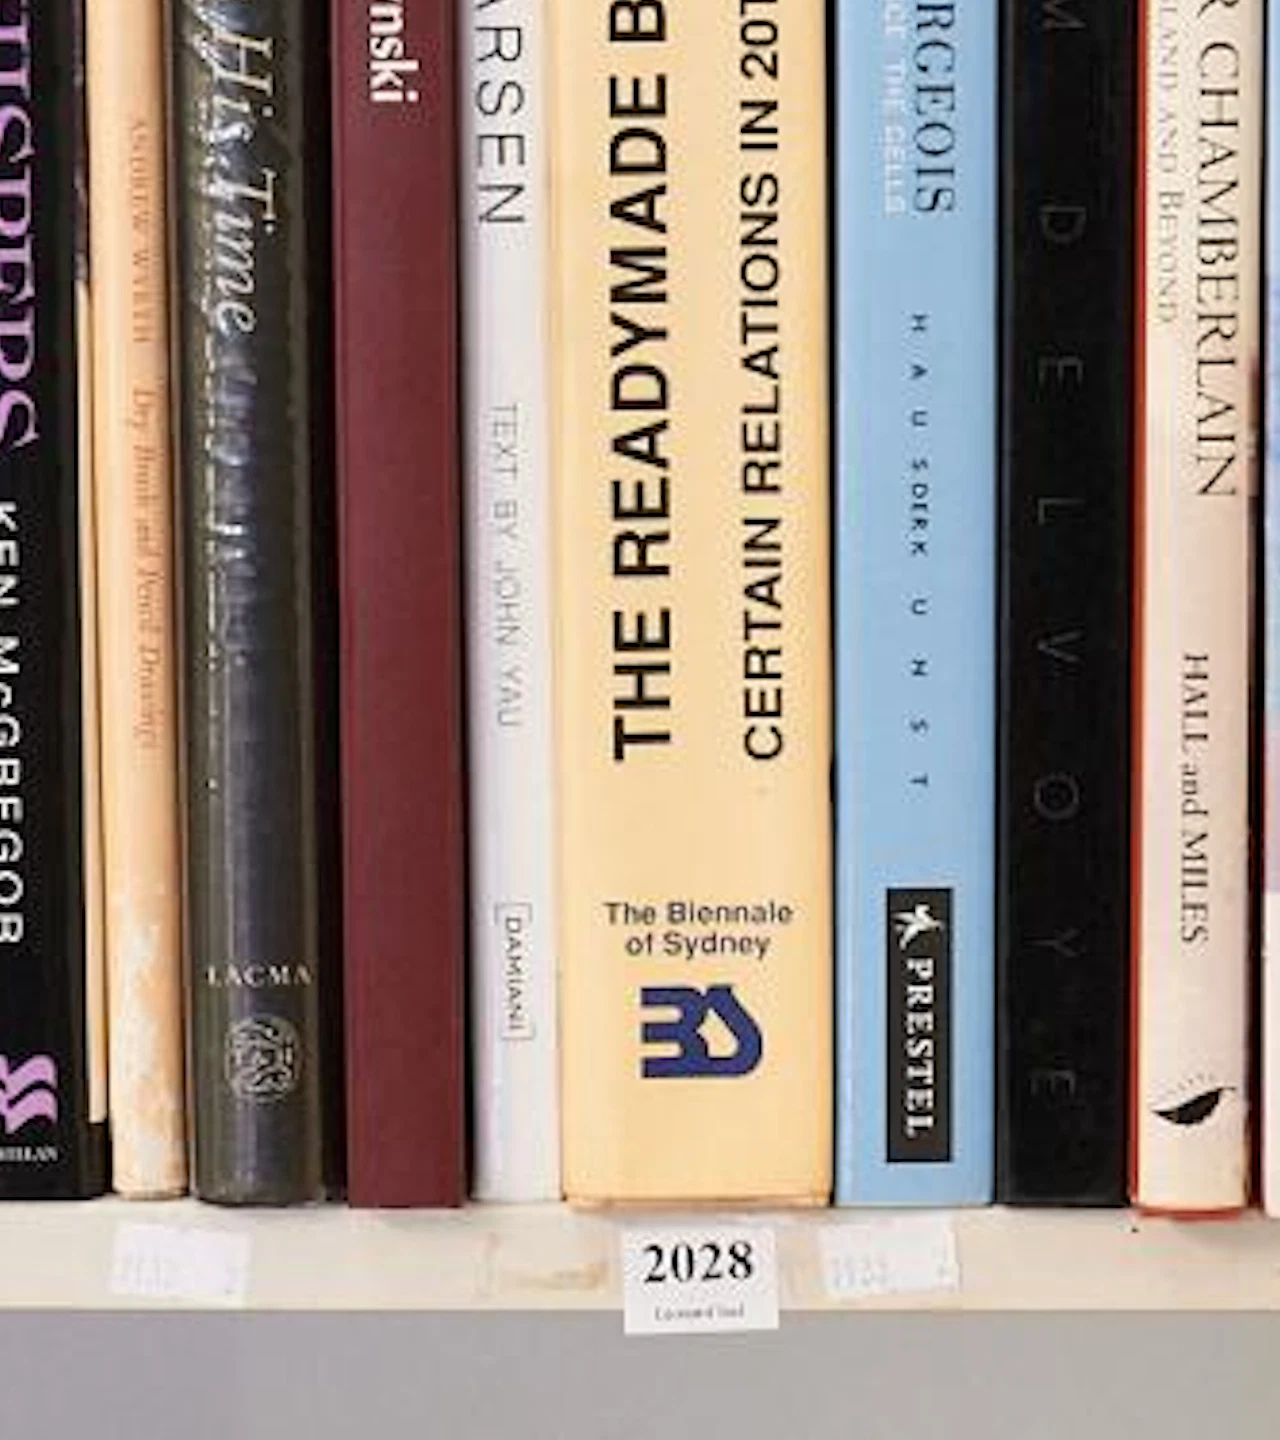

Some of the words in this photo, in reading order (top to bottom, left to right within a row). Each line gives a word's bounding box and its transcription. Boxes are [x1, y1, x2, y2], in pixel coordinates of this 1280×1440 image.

[739, 99, 779, 151] IN
[1197, 40, 1240, 496] CHAMBERLAIN
[609, 73, 671, 578] READYMADE
[740, 172, 781, 495] RELATIONS
[491, 403, 521, 480] TEXT
[492, 501, 521, 540] BY
[493, 559, 523, 648] JOHN
[742, 518, 782, 761] CERTAIN
[495, 664, 526, 730] YAU
[613, 607, 672, 763] THE
[1180, 651, 1209, 749] HALL
[1181, 762, 1208, 816] and
[603, 901, 656, 925] The
[667, 899, 794, 925] Biennale
[1180, 830, 1209, 944] MILES
[207, 964, 312, 987] LACMA
[501, 914, 527, 1032] DAMIANI
[625, 932, 653, 957] of
[663, 930, 771, 961] Sydney
[906, 957, 936, 1139] PRESTEL
[643, 1241, 754, 1283] 2028
